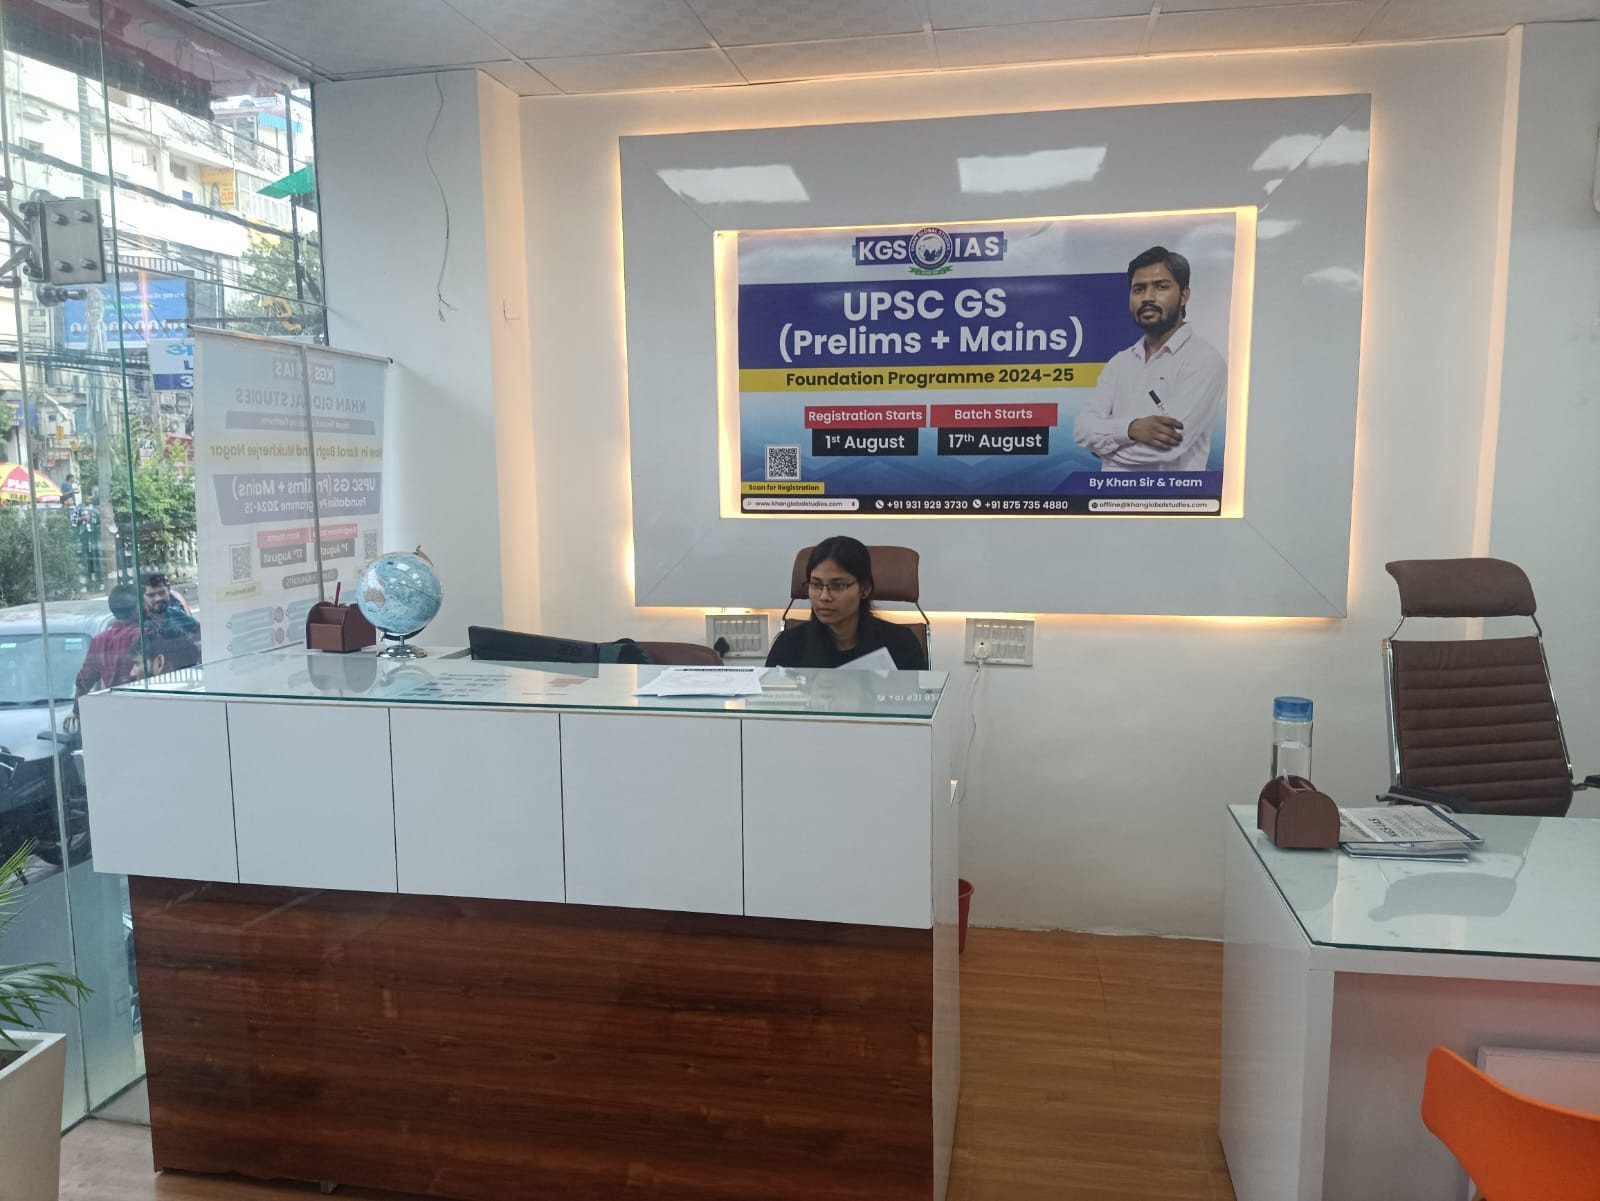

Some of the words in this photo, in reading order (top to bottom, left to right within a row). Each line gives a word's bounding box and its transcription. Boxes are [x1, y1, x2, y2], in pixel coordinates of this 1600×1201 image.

[859, 240, 907, 261] KGS
[955, 236, 1000, 258] IAS
[843, 289, 944, 321] UPSC
[954, 288, 1007, 319] GS
[779, 323, 921, 363] (Prelims
[930, 329, 950, 350] +
[959, 316, 1084, 358] Mains)
[786, 371, 884, 386] Foundation
[888, 370, 995, 388] Programme
[998, 368, 1074, 383] 2024-25
[808, 410, 882, 425] Registration
[885, 410, 923, 421] Starts
[954, 409, 992, 420] Batch
[994, 408, 1033, 420] Starts
[825, 435, 840, 449] 1st
[844, 435, 905, 453] August
[948, 433, 975, 448] 17th
[978, 433, 1042, 452] August
[748, 484, 766, 492] Scan
[767, 484, 776, 492] for
[777, 484, 820, 493] Registration
[1089, 478, 1104, 489] By
[1106, 478, 1137, 487] Khan
[1139, 477, 1154, 487] Sir
[1156, 478, 1166, 487] &
[1169, 478, 1202, 487] Team
[887, 501, 903, 509] +91
[905, 501, 921, 509] 931
[923, 500, 942, 509] 929
[944, 500, 968, 509] 3730
[984, 501, 1001, 509] +91
[1002, 501, 1021, 510] 875
[1022, 500, 1041, 509] 735
[1042, 500, 1069, 509] 4880
